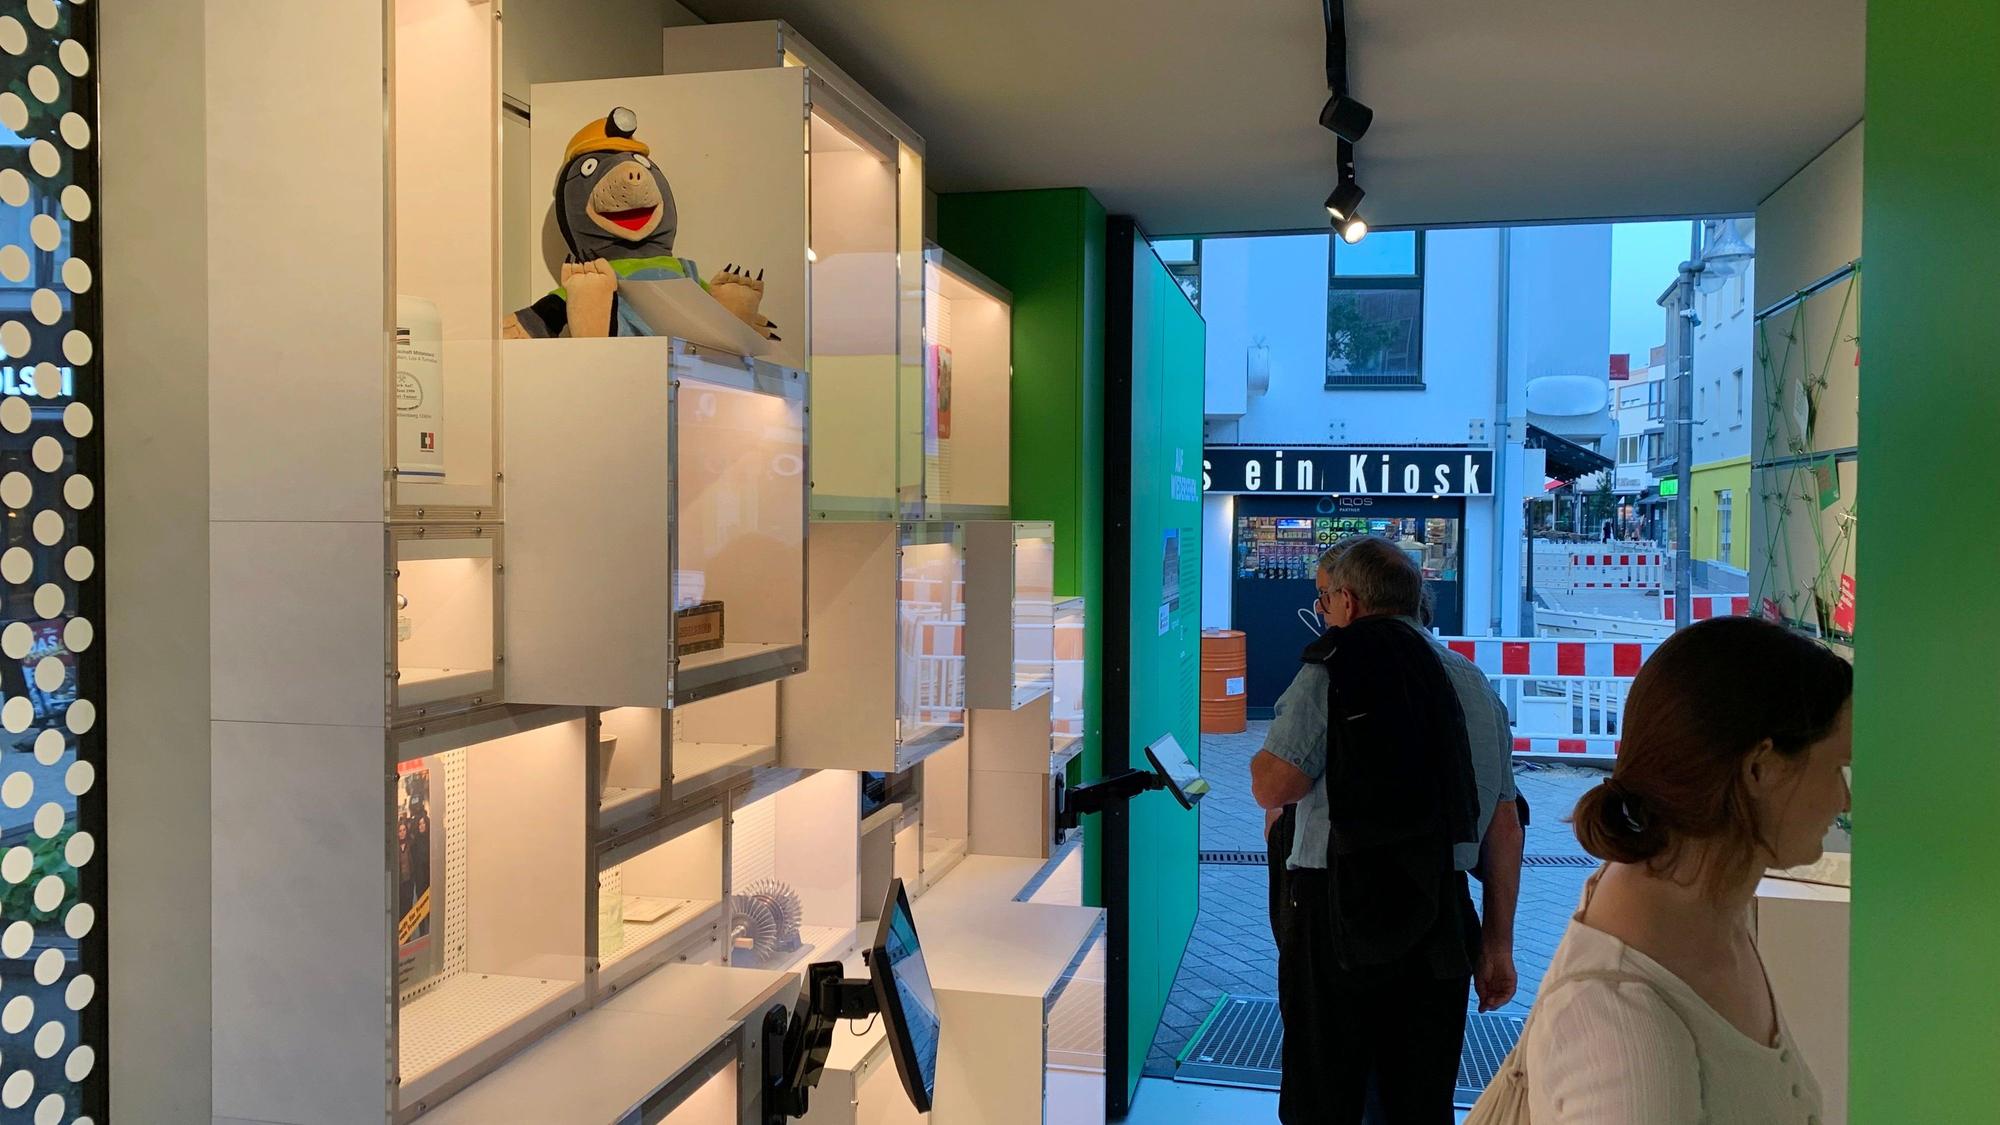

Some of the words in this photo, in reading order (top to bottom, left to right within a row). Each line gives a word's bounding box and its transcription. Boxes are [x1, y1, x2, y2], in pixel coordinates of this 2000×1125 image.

[0, 366, 73, 396] LSI
[1245, 450, 1314, 490] ein
[1349, 454, 1480, 494] Kiosk
[1339, 497, 1373, 507] IQOS
